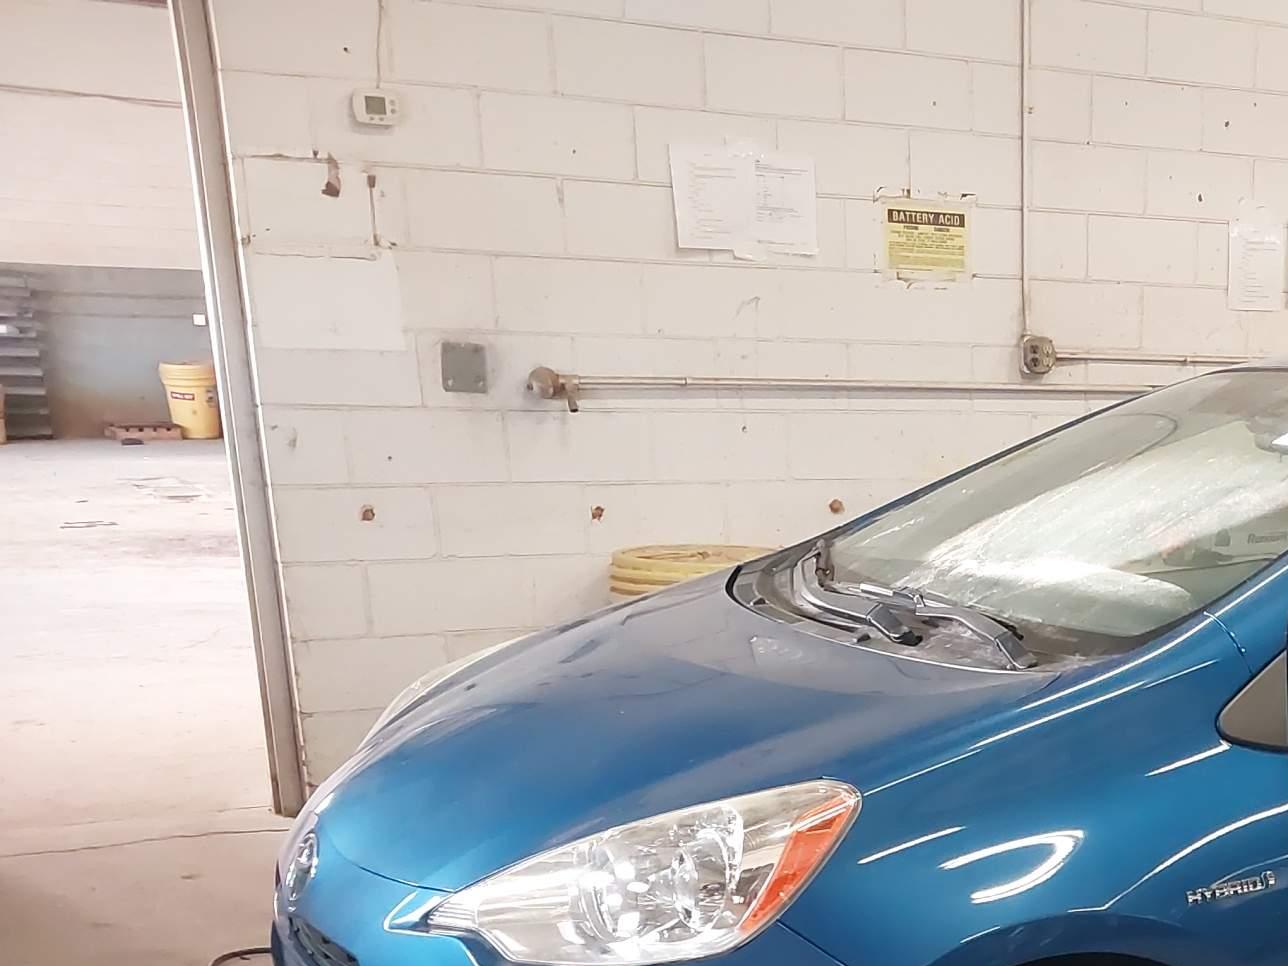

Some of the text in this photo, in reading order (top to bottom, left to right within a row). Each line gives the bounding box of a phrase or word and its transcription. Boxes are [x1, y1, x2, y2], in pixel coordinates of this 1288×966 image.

[892, 211, 960, 226] BATTERY ACID
[1186, 876, 1265, 904] HYBRID
